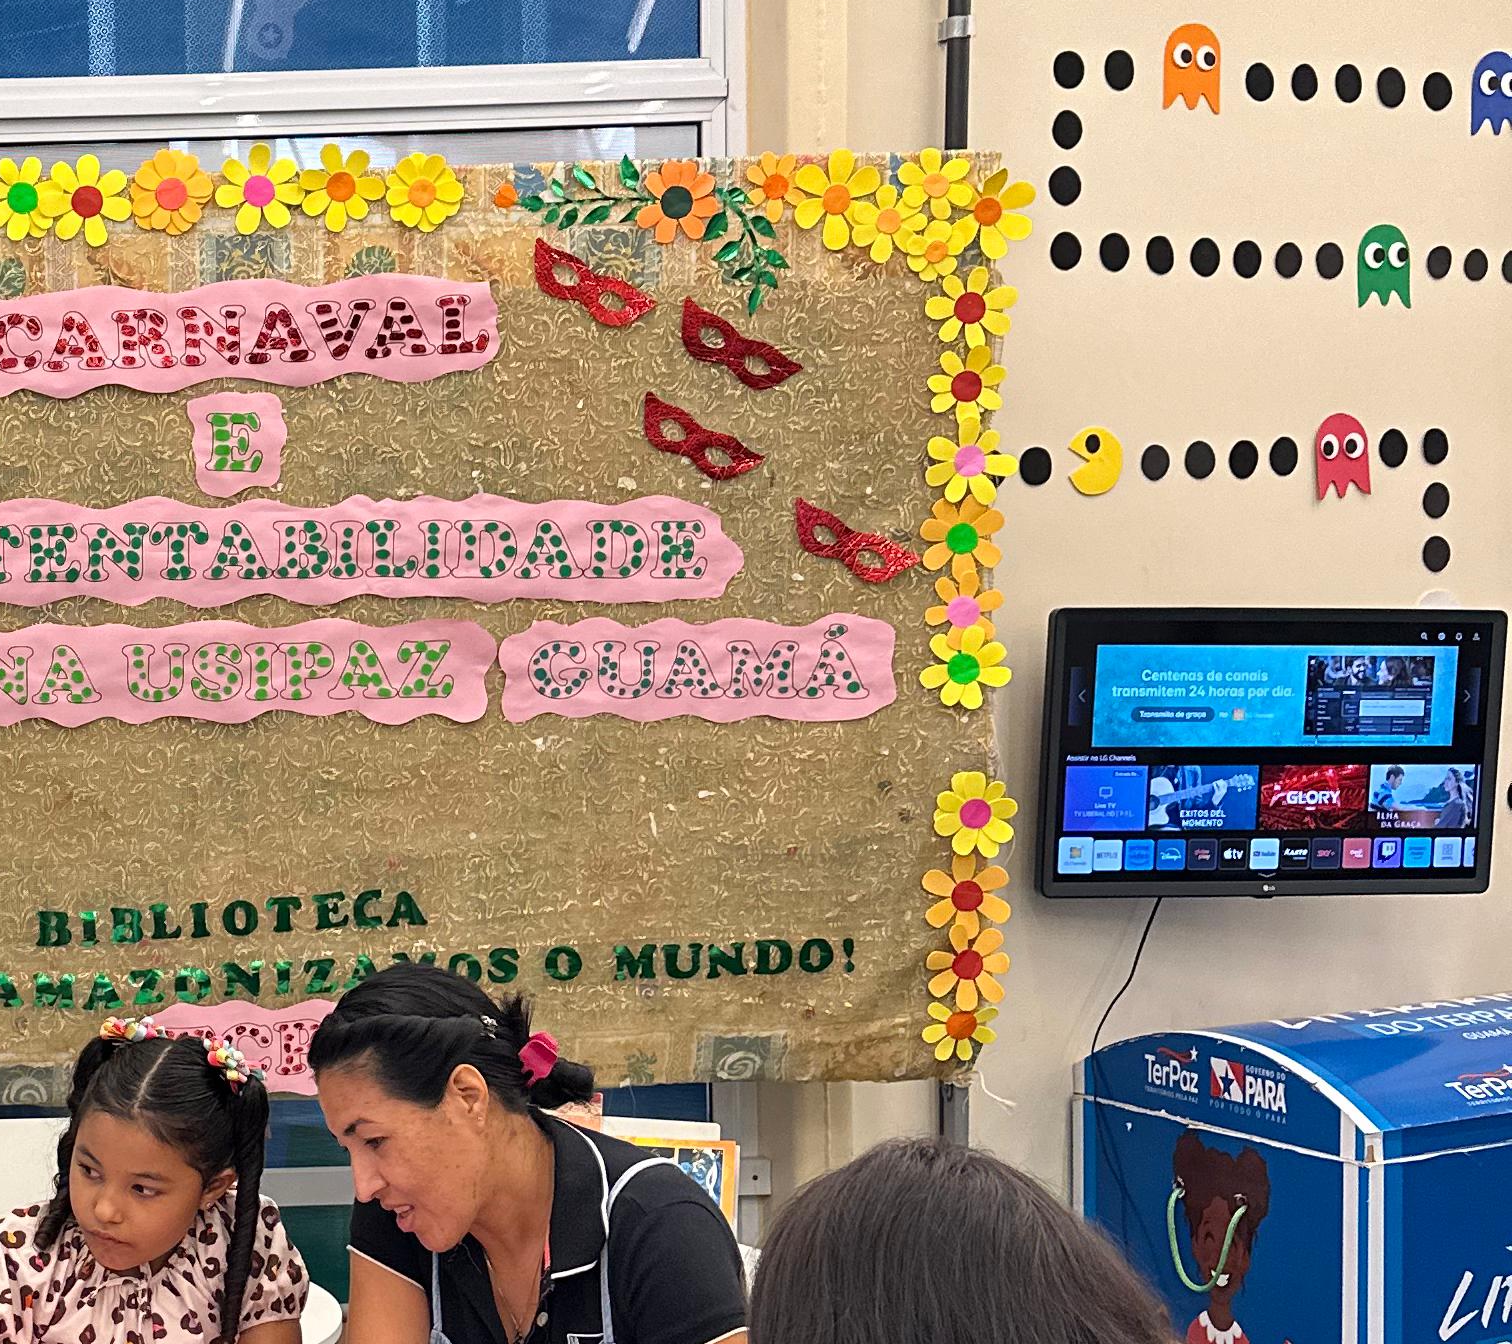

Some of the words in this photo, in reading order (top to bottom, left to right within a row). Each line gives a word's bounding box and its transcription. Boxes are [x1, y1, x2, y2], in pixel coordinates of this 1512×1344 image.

[204, 411, 264, 473] E
[124, 639, 453, 703] USIPAZ
[527, 623, 871, 700] GUAMÁ
[1141, 669, 1203, 682] Centenas
[1206, 669, 1223, 682] de
[1225, 669, 1269, 682] canais
[1112, 686, 1186, 698] transmitem
[1188, 685, 1206, 698] 24
[1209, 685, 1245, 698] horas
[1248, 687, 1270, 700] por
[1286, 789, 1341, 805] GLORY
[36, 888, 428, 948] BIBLIOTECA
[544, 945, 583, 981] O
[613, 937, 855, 981] MUNDO!
[1364, 1019, 1425, 1036] DO
[1416, 1005, 1512, 1029] TERPA
[1144, 1053, 1199, 1093] TerPaz
